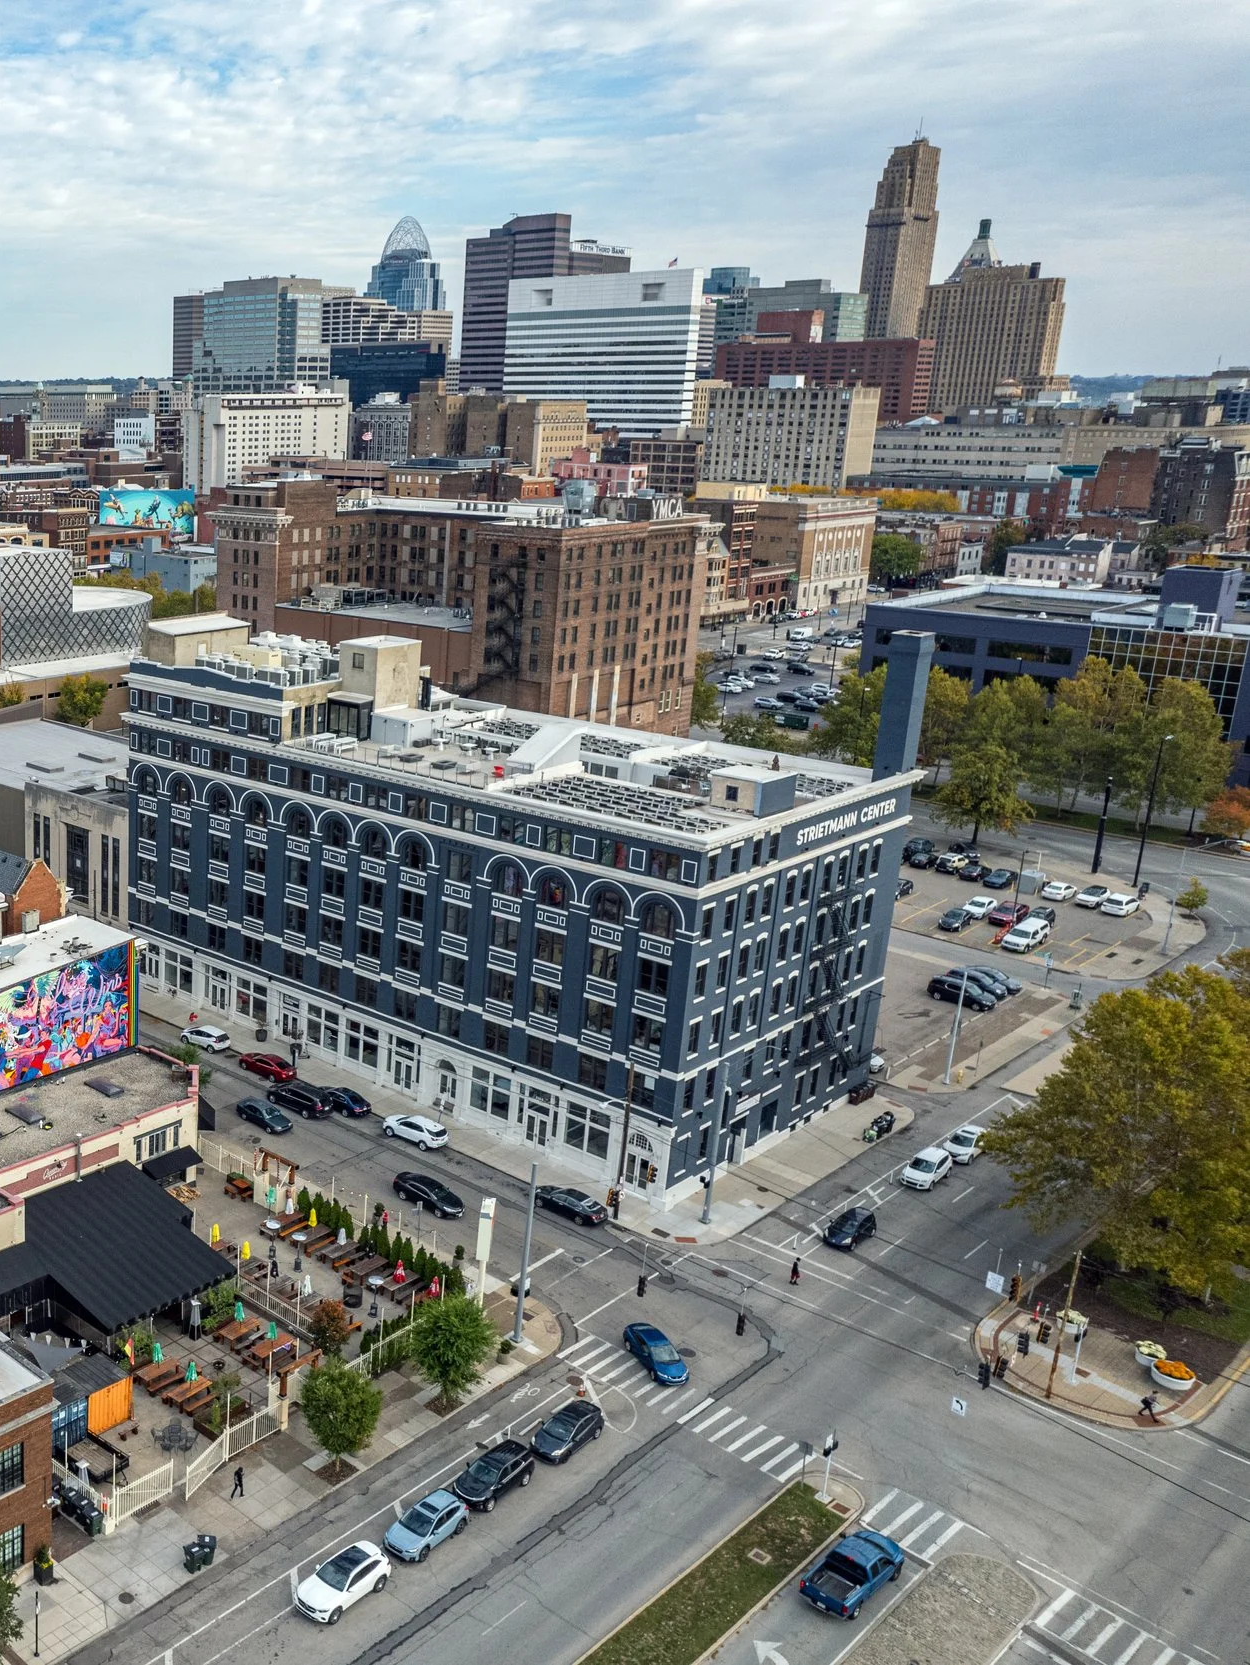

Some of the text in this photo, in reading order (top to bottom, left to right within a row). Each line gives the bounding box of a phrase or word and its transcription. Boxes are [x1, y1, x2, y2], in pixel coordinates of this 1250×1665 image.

[611, 247, 626, 255] BANK
[652, 498, 683, 520] YMCA
[796, 798, 897, 846] STRIETMANN CENTER
